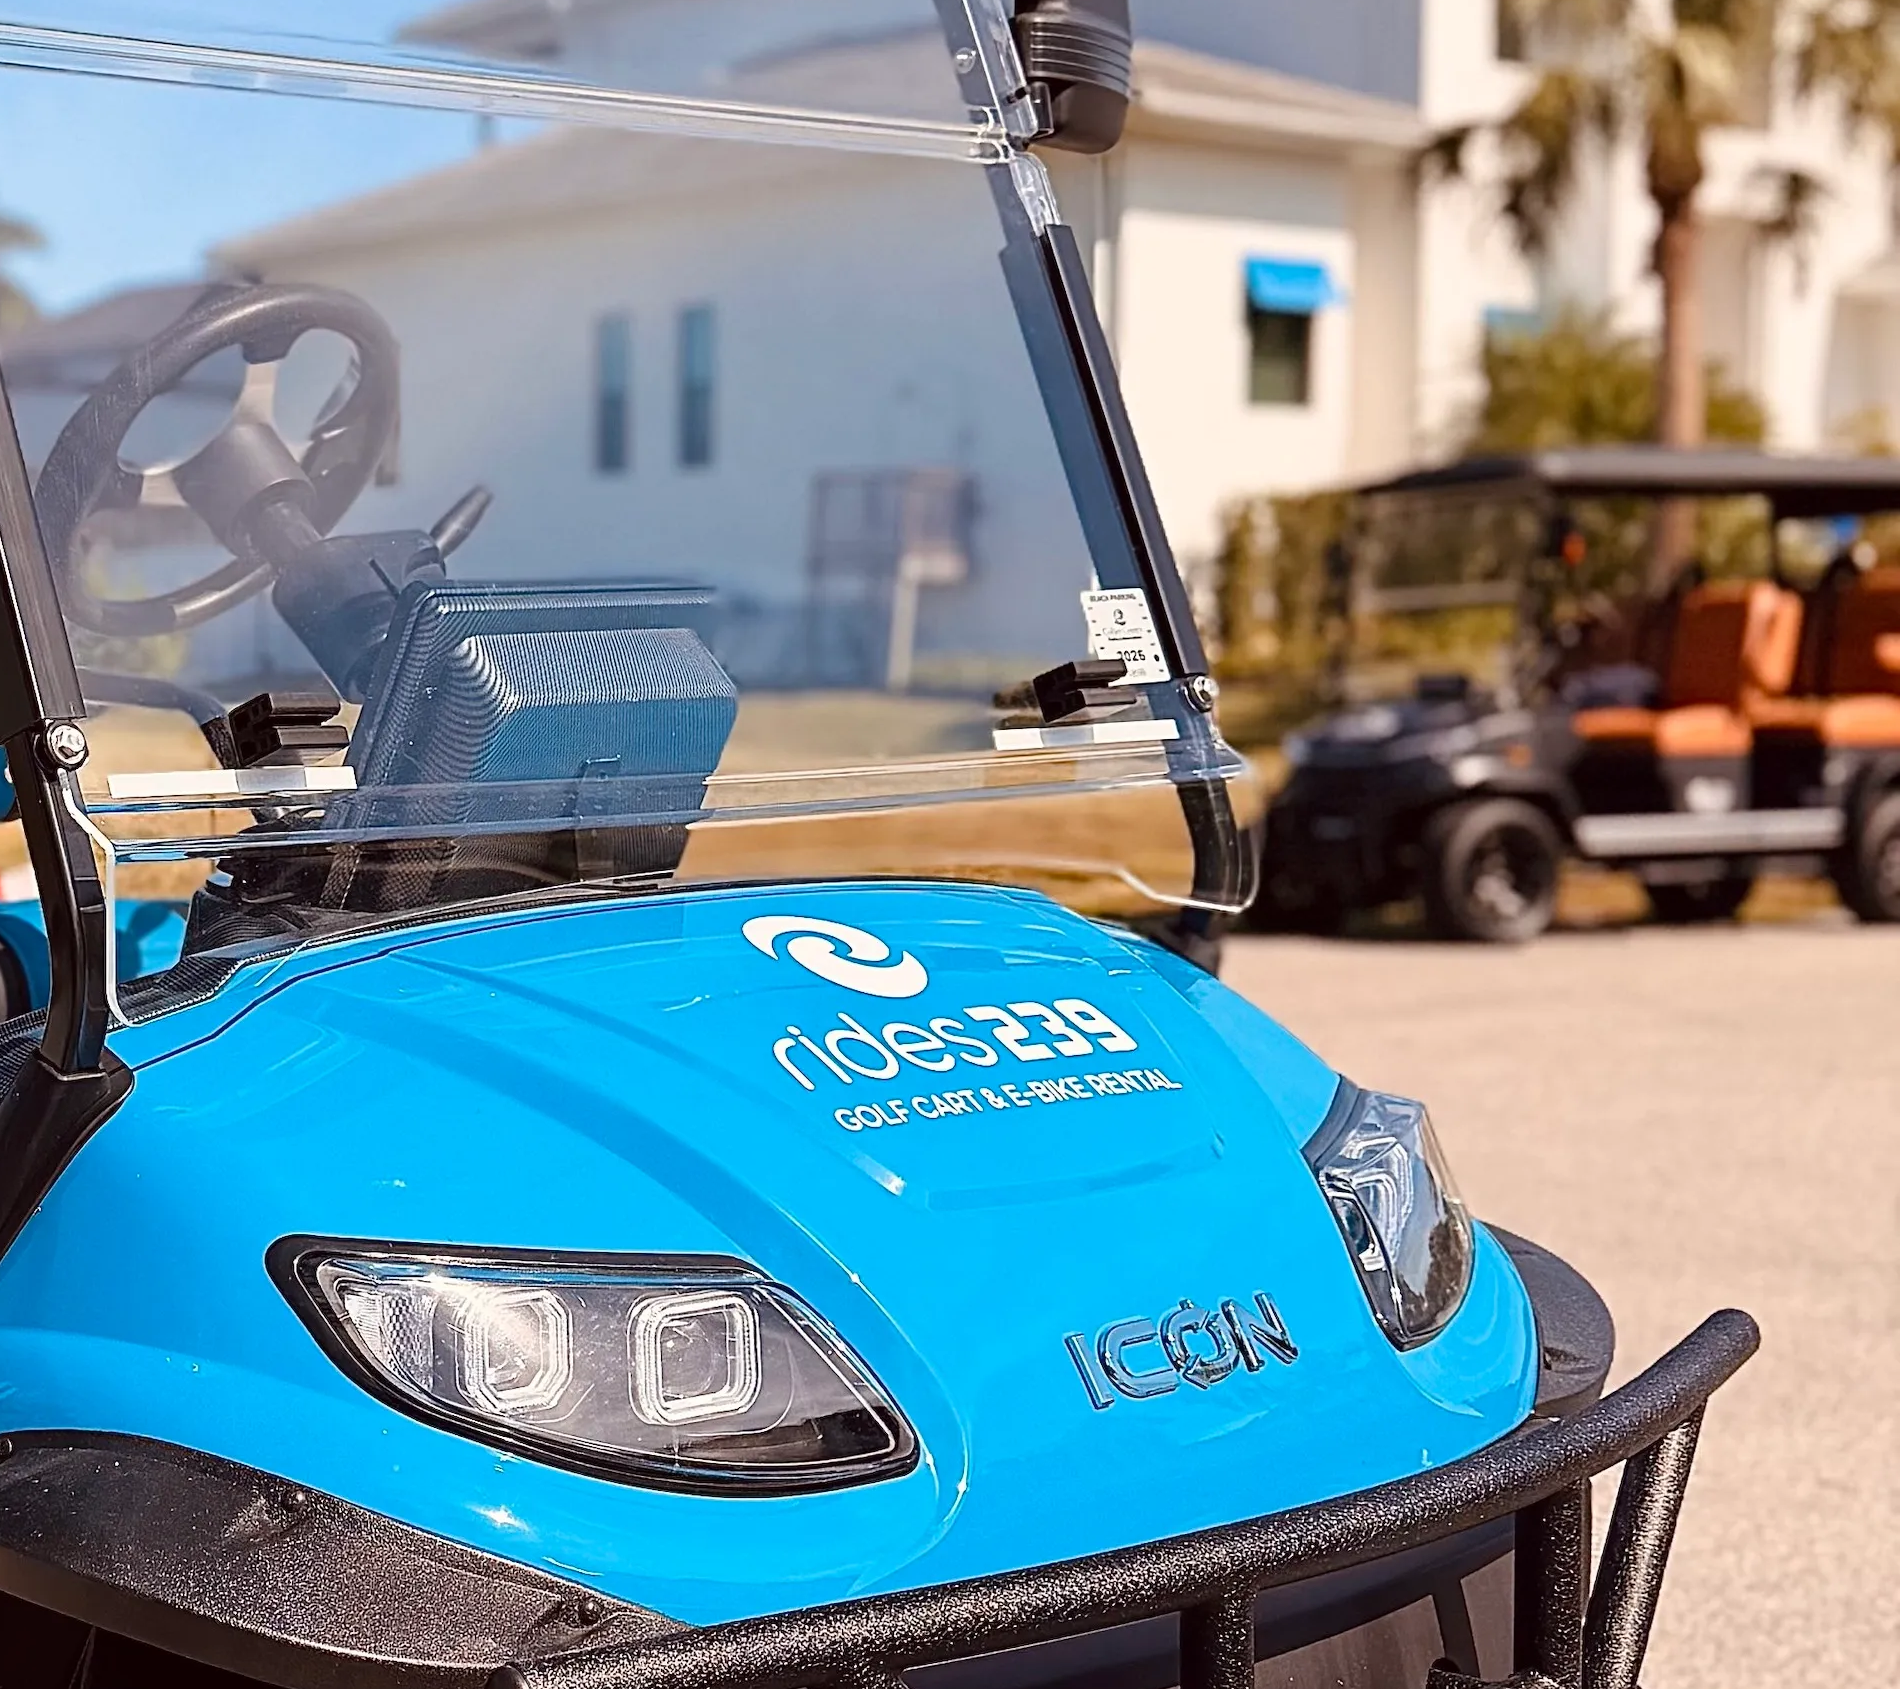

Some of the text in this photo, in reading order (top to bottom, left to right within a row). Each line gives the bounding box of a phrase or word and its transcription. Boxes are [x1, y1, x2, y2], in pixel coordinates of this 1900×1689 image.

[833, 1068, 1183, 1133] GOLF CART & E-BIKE RENTAL
[1063, 1292, 1299, 1410] ICON
